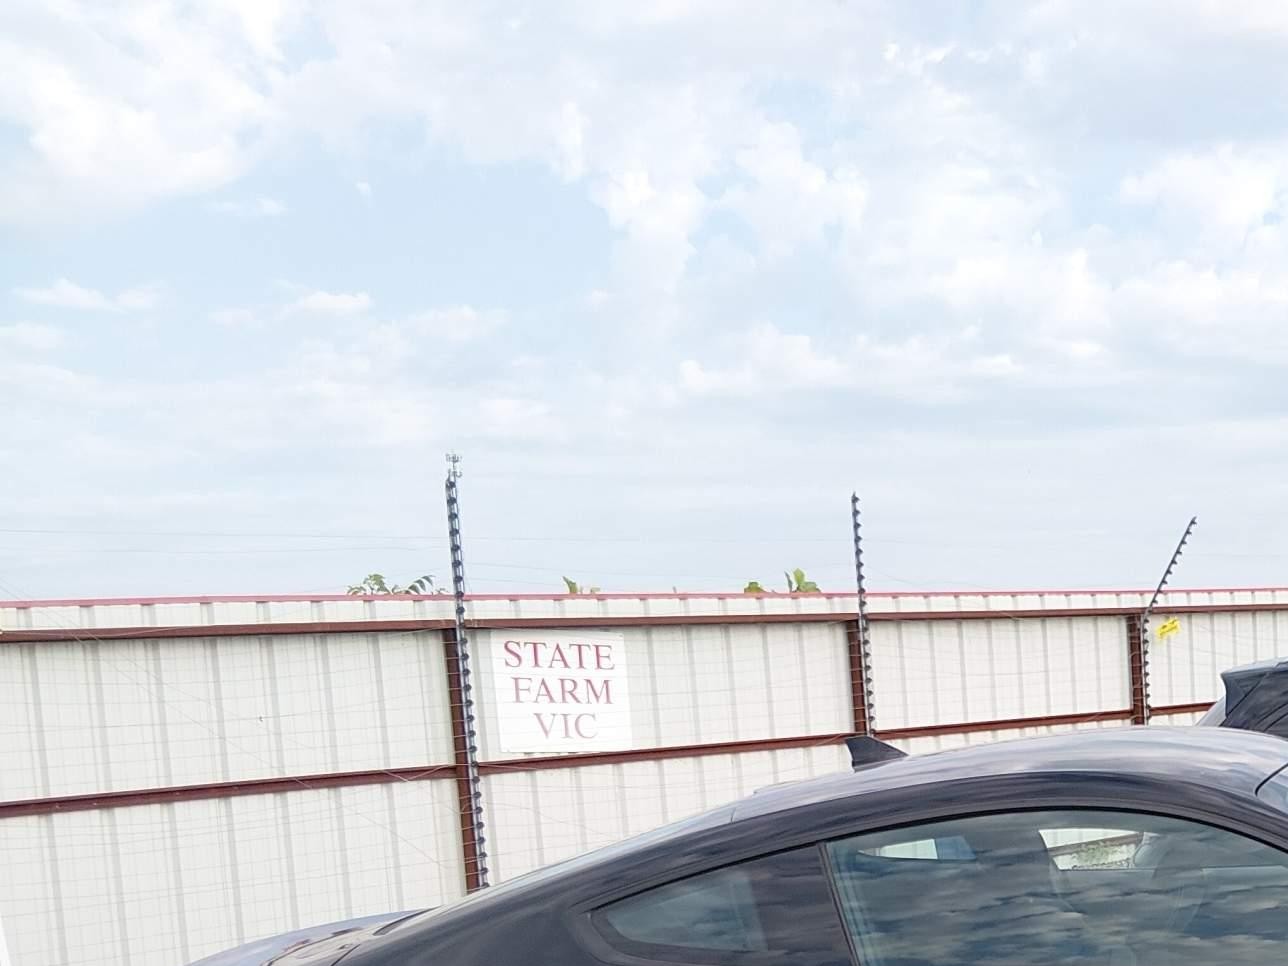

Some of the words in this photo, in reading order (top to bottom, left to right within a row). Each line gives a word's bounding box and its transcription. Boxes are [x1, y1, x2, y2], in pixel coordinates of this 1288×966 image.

[503, 639, 616, 671] STATE
[510, 676, 615, 705] FARM
[532, 712, 599, 740] VIC
